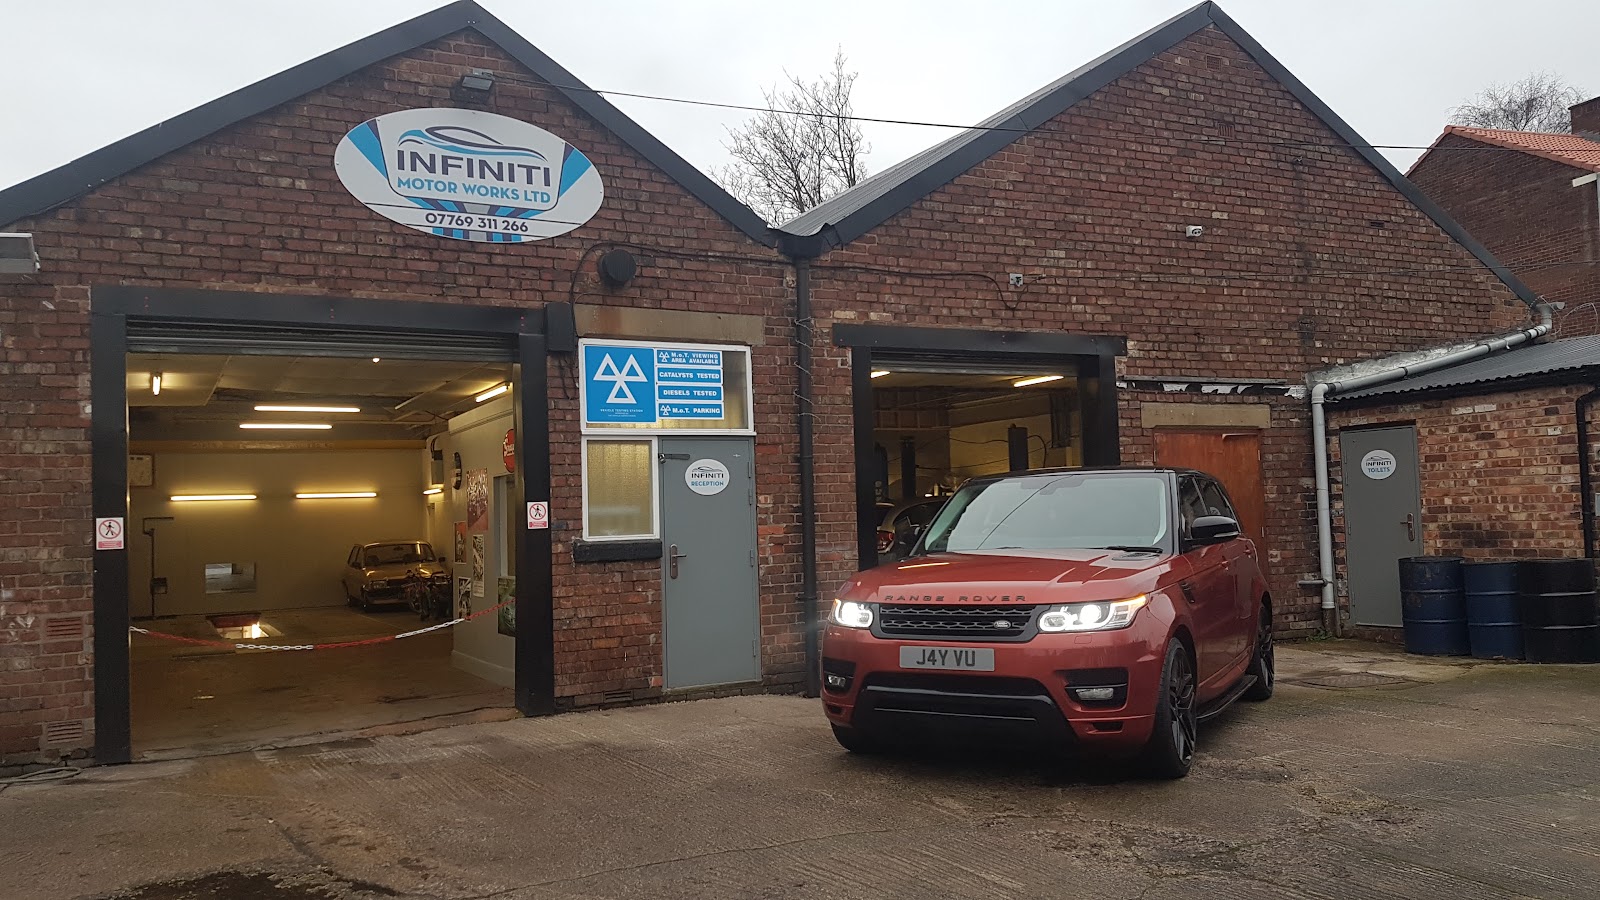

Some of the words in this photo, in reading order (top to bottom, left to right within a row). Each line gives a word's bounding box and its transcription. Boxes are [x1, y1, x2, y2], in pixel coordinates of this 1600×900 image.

[397, 150, 551, 187] INFINITI
[397, 176, 458, 194] MOTOR
[462, 183, 520, 201] WORKS
[523, 189, 551, 203] LTD
[425, 212, 474, 228] 07769
[477, 218, 498, 230] 311
[502, 221, 529, 233] 266
[916, 649, 949, 666] J4Y
[954, 650, 976, 667] VU
